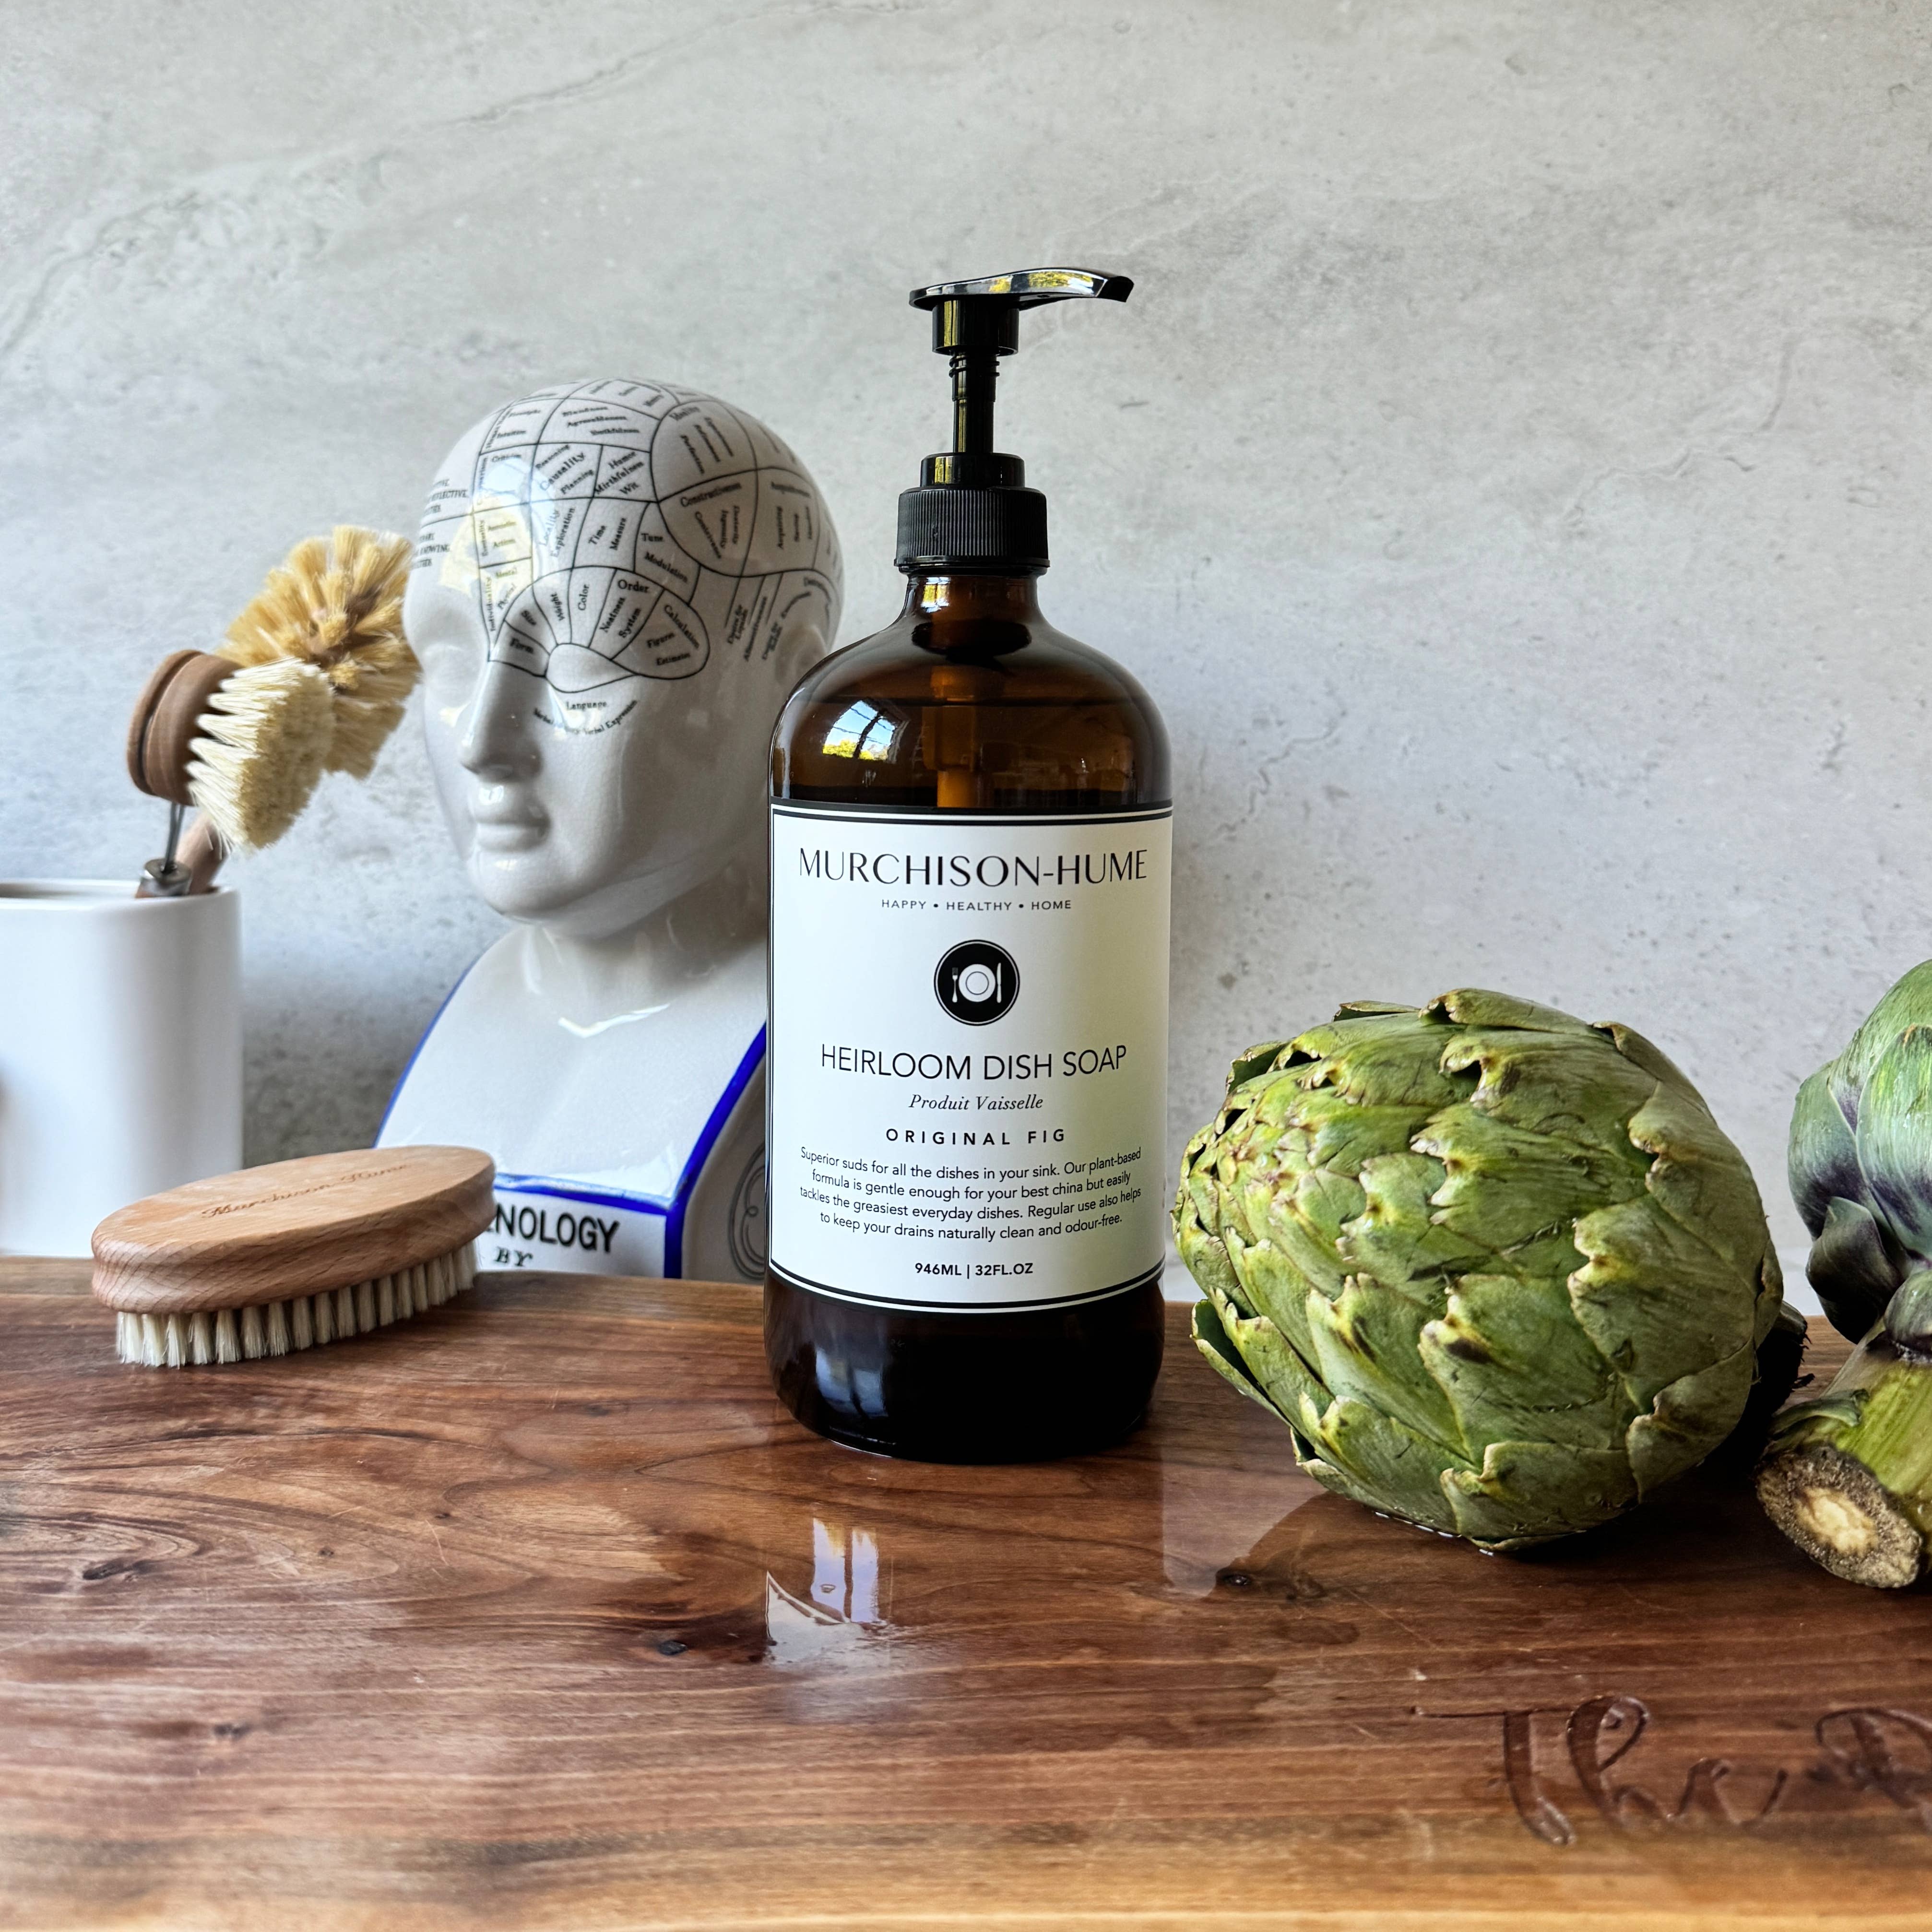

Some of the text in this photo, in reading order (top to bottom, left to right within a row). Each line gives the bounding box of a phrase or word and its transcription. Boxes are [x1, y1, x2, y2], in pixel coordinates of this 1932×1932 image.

[540, 452, 586, 492] Causality
[560, 469, 594, 495] Planning
[619, 481, 640, 495] Wit
[537, 509, 561, 546] Locality
[549, 507, 576, 558] Exploration
[588, 525, 607, 545] Time
[609, 517, 627, 551] Measure
[641, 533, 664, 542] Tune
[617, 579, 649, 593] Order
[550, 592, 566, 622] Weight
[566, 701, 607, 711] Language
[800, 847, 1148, 887] MURCHISON-HUME
[882, 899, 1071, 911] HAPPY HEALTHY HOME
[822, 1043, 1126, 1080] HEIRLOOM DISH SOAP
[908, 1093, 1043, 1110] Produit Vaisselle
[886, 1128, 1066, 1146] ORIGINAL FIG
[801, 1146, 1141, 1183] Superior suds for all the dishes in your sink. Our plant-based
[812, 1168, 1131, 1203] formula is gentle enough for your best china but easily
[800, 1186, 1141, 1223] tackles the greasiest everyday dishes. Regular use also helps
[487, 1203, 620, 1253] NOLOGY
[820, 1211, 1122, 1243] to keep your drains naturally clean and odour-free.
[494, 1246, 533, 1267] BY
[914, 1262, 1033, 1276] 946ML 32FL.OZ
